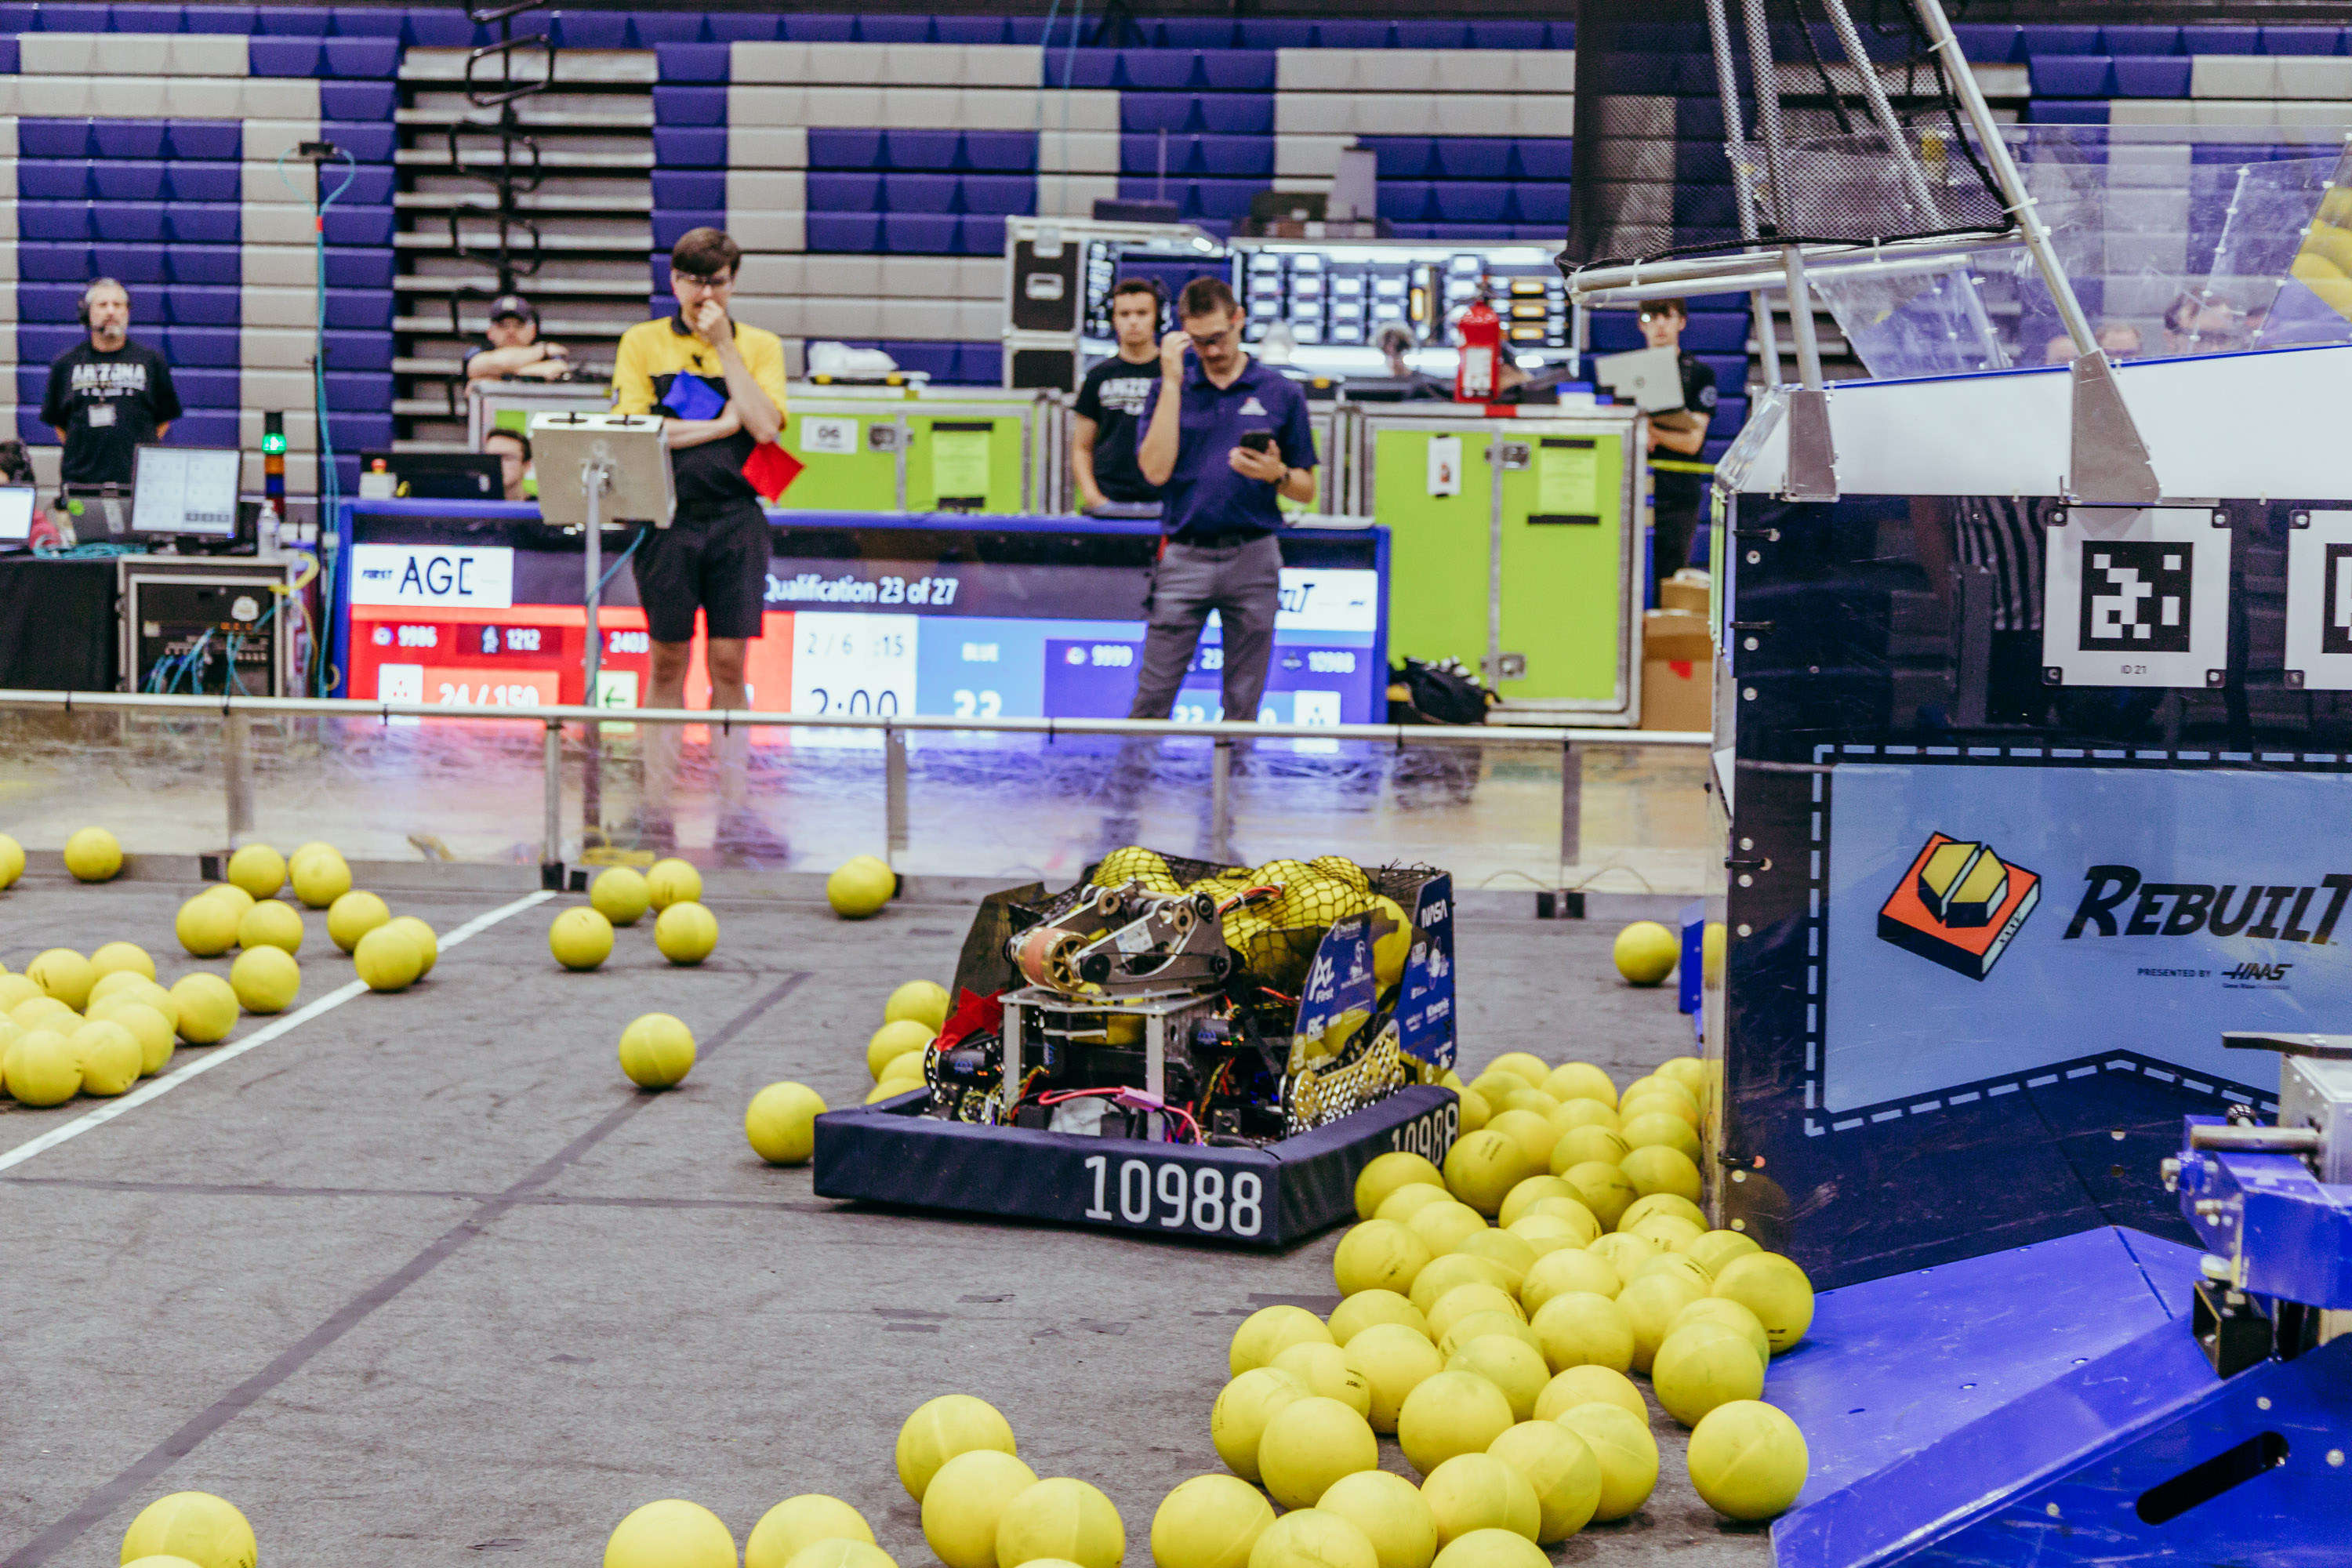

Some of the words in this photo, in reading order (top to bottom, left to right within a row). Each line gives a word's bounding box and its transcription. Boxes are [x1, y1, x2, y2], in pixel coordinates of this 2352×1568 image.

[399, 557, 474, 595] AGE
[878, 576, 905, 604] 23
[906, 577, 931, 604] of
[930, 578, 959, 605] 27
[506, 629, 541, 650] 1212
[2121, 665, 2132, 674] ID
[2134, 665, 2147, 674] 21
[1421, 898, 1448, 928] NASA
[2062, 865, 2352, 946] REBUILT
[2137, 967, 2195, 978] PRESENTED
[2221, 963, 2294, 981] HAAS
[1084, 1155, 1263, 1237] 10988
